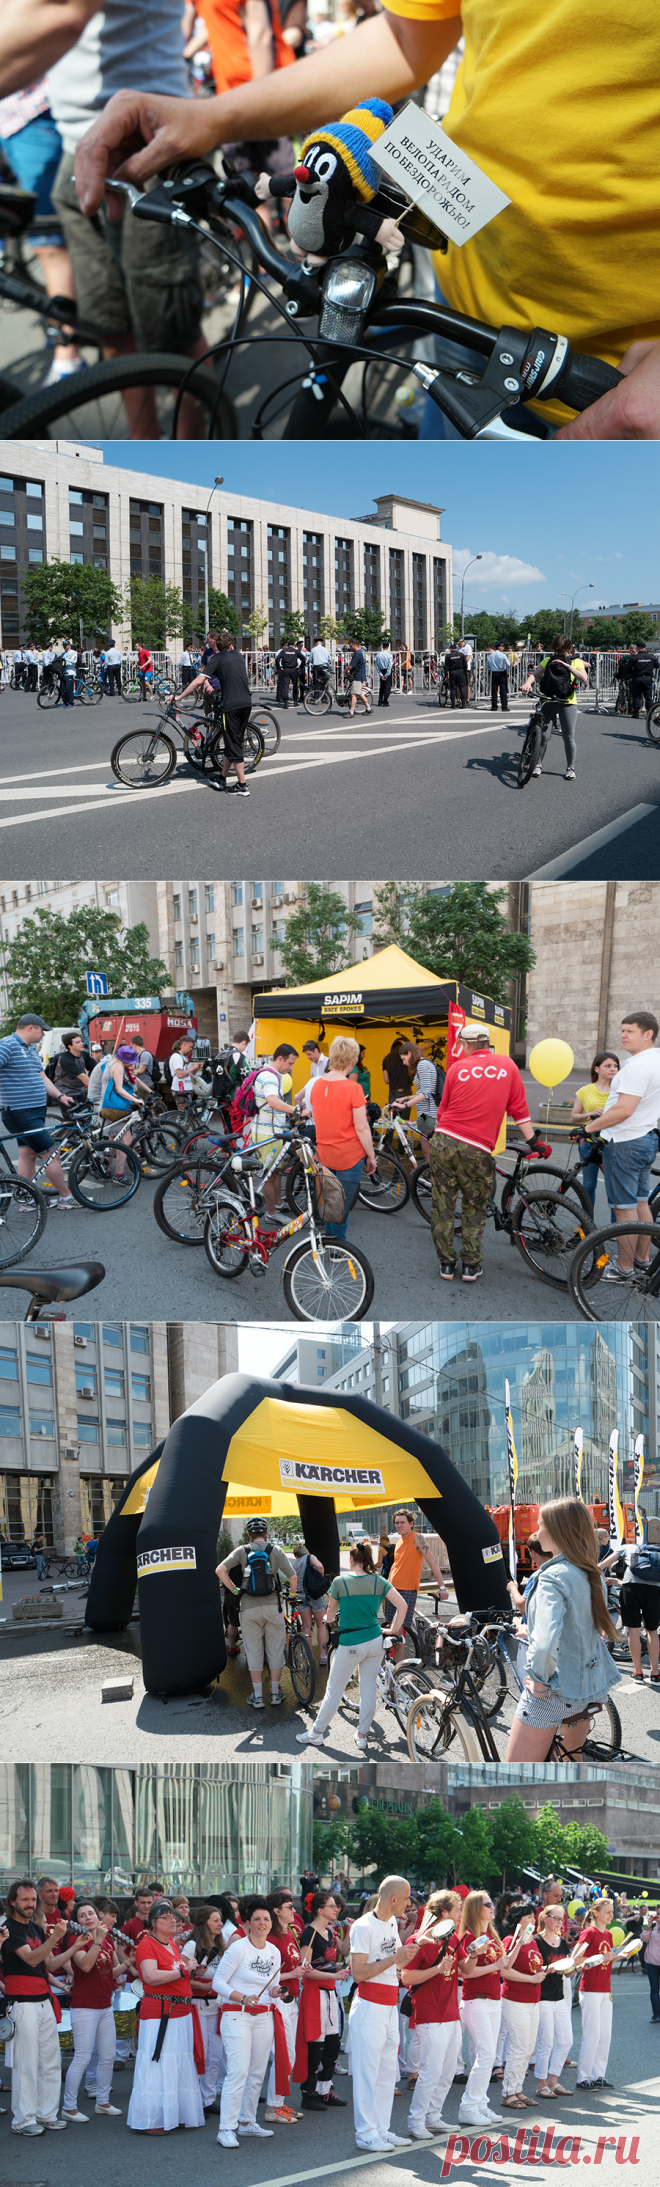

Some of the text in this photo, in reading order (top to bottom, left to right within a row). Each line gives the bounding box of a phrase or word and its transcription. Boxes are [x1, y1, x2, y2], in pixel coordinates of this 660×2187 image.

[426, 140, 471, 186] УДАРИМ
[400, 136, 475, 213] ВЕЛОПАРАДОМ
[399, 156, 471, 229] БЕЗДОРОЖЬЮ!
[134, 997, 152, 1009] 335
[324, 993, 363, 1005] SAPIM
[458, 1066, 507, 1081] СССР
[295, 1463, 381, 1484] KÄRCHER
[137, 1547, 194, 1568] ÄRCHER
[371, 1798, 412, 1814] СБЕРБАНК
